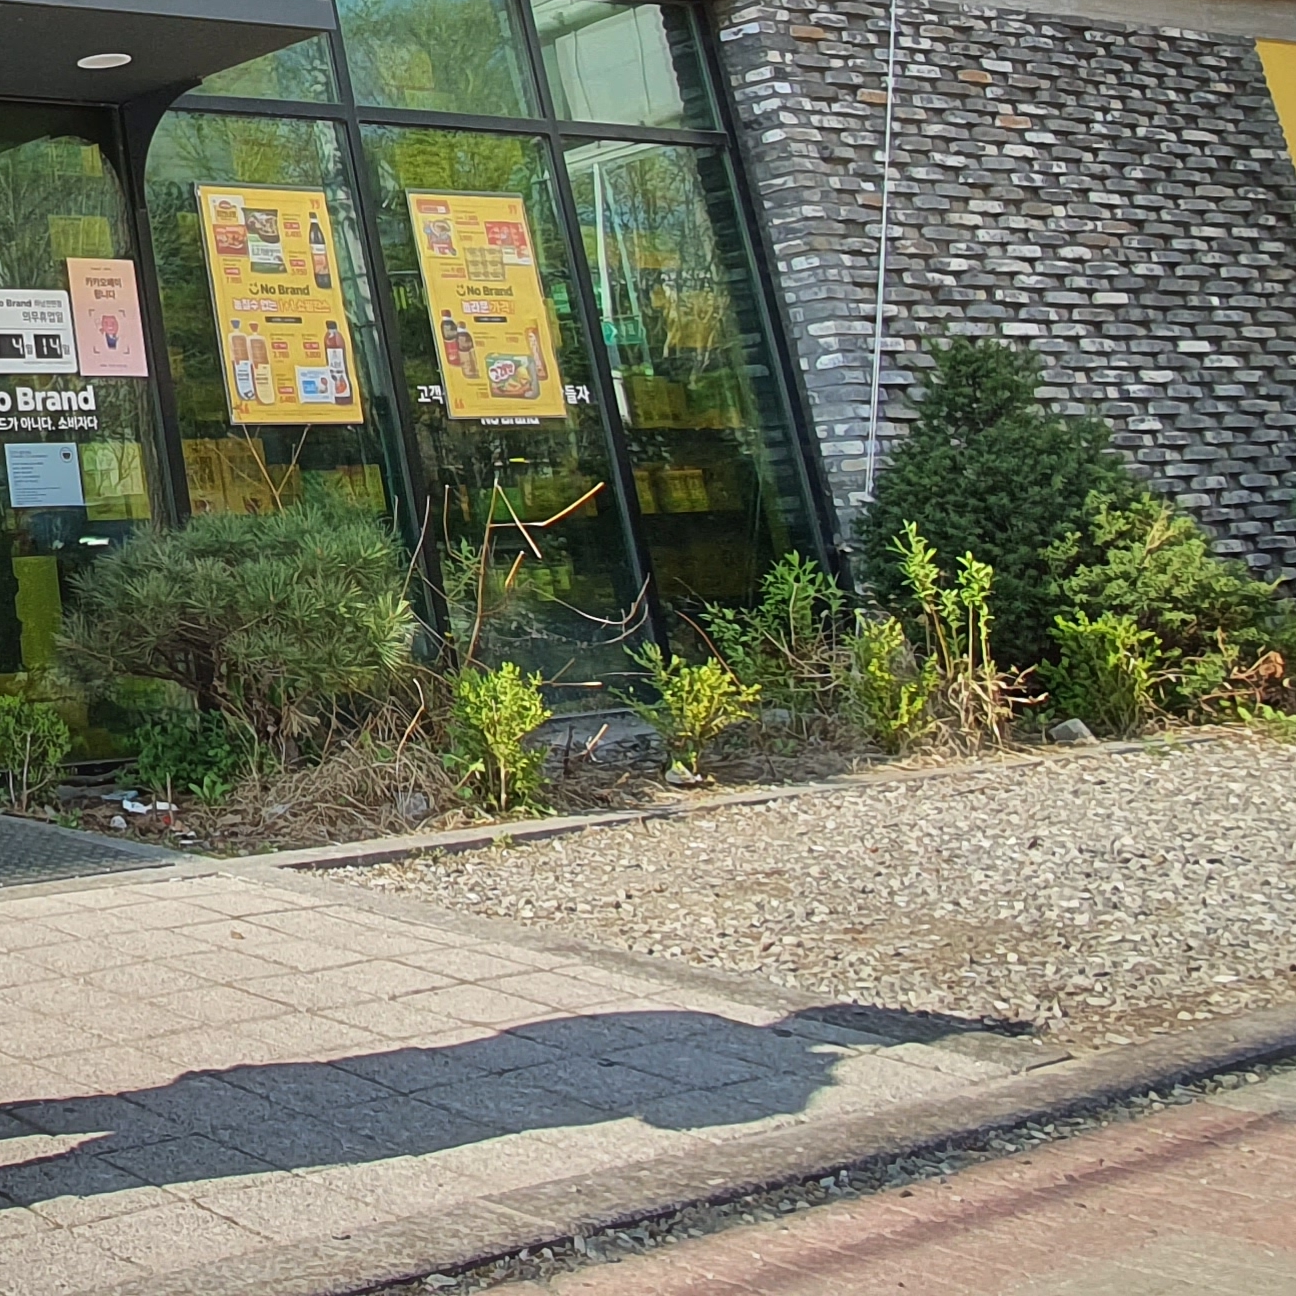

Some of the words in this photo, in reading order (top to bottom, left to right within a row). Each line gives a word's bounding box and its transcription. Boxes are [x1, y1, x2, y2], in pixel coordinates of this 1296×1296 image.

[260, 284, 277, 295] No
[277, 285, 311, 296] Brand
[467, 285, 481, 295] No
[483, 285, 514, 297] Brand
[6, 299, 32, 308] Brand
[42, 337, 61, 355] 14
[15, 385, 96, 412] Brand
[561, 385, 591, 404] 들자
[20, 416, 56, 431] 아니다.
[58, 416, 98, 430] 소비자다
